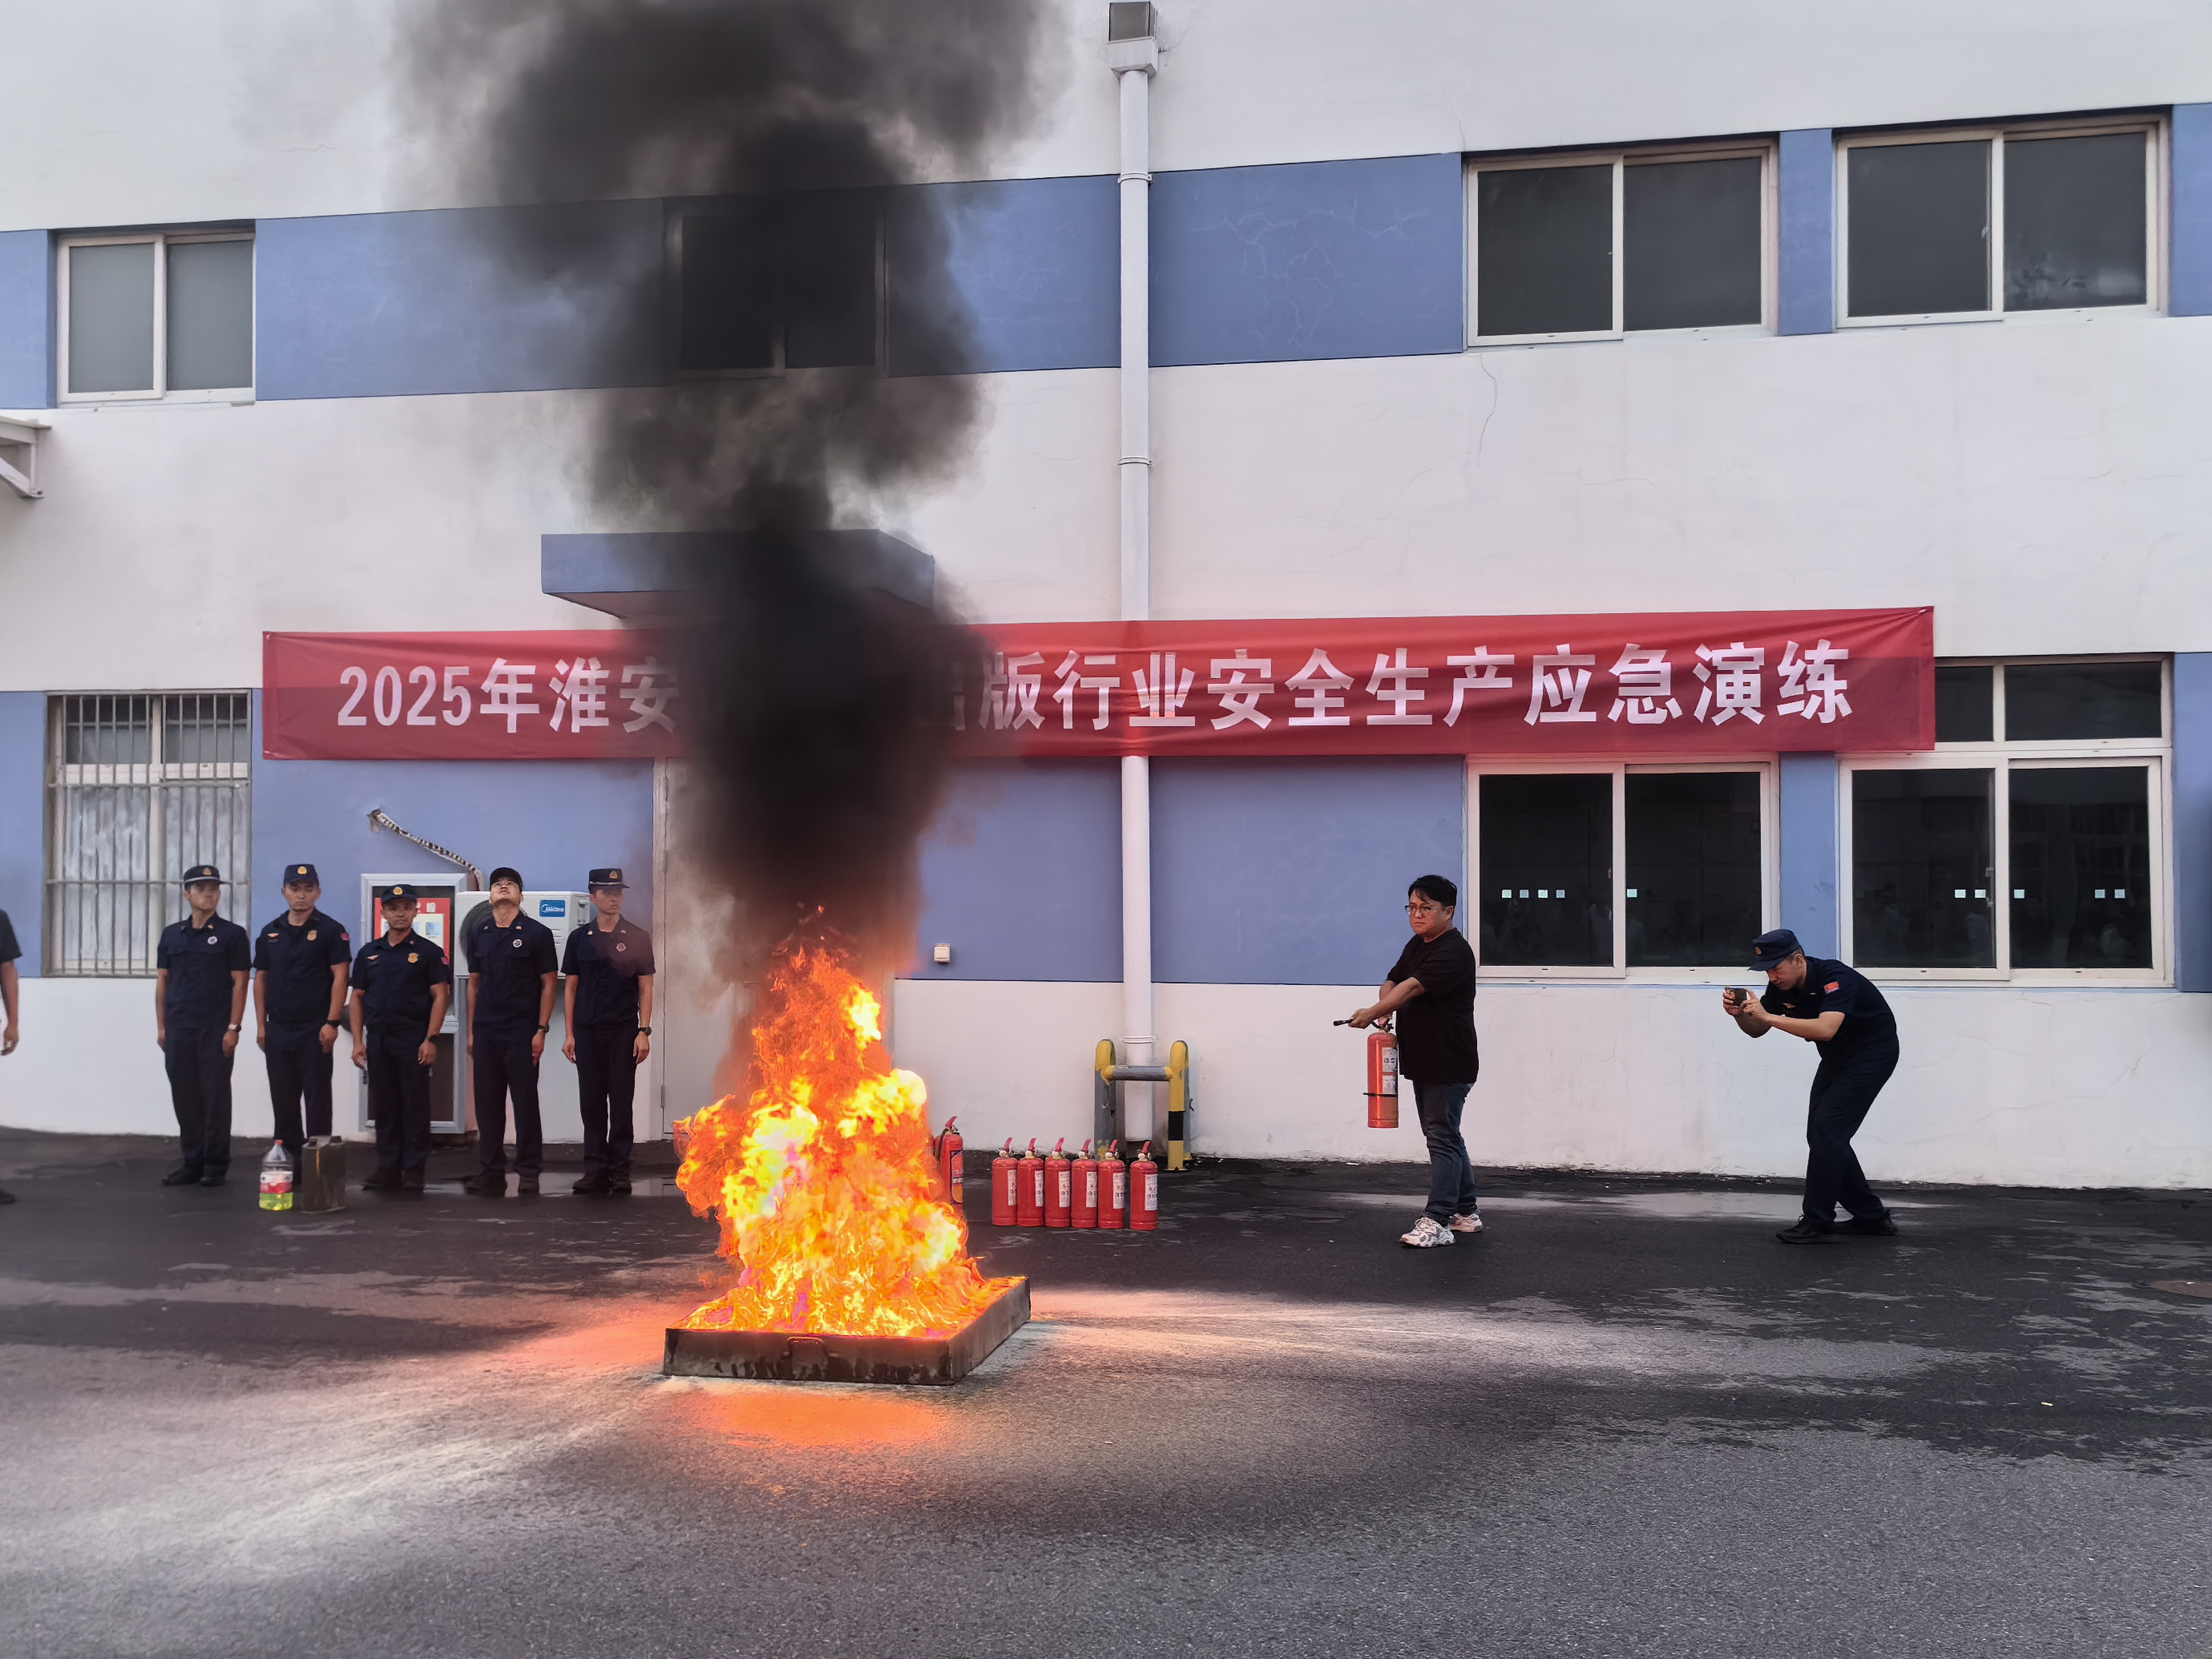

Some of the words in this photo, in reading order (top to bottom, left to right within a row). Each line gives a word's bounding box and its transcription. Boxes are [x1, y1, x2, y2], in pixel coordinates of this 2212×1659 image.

[337, 639, 1854, 733] 2025年淮安版行业安全生产应急演练
